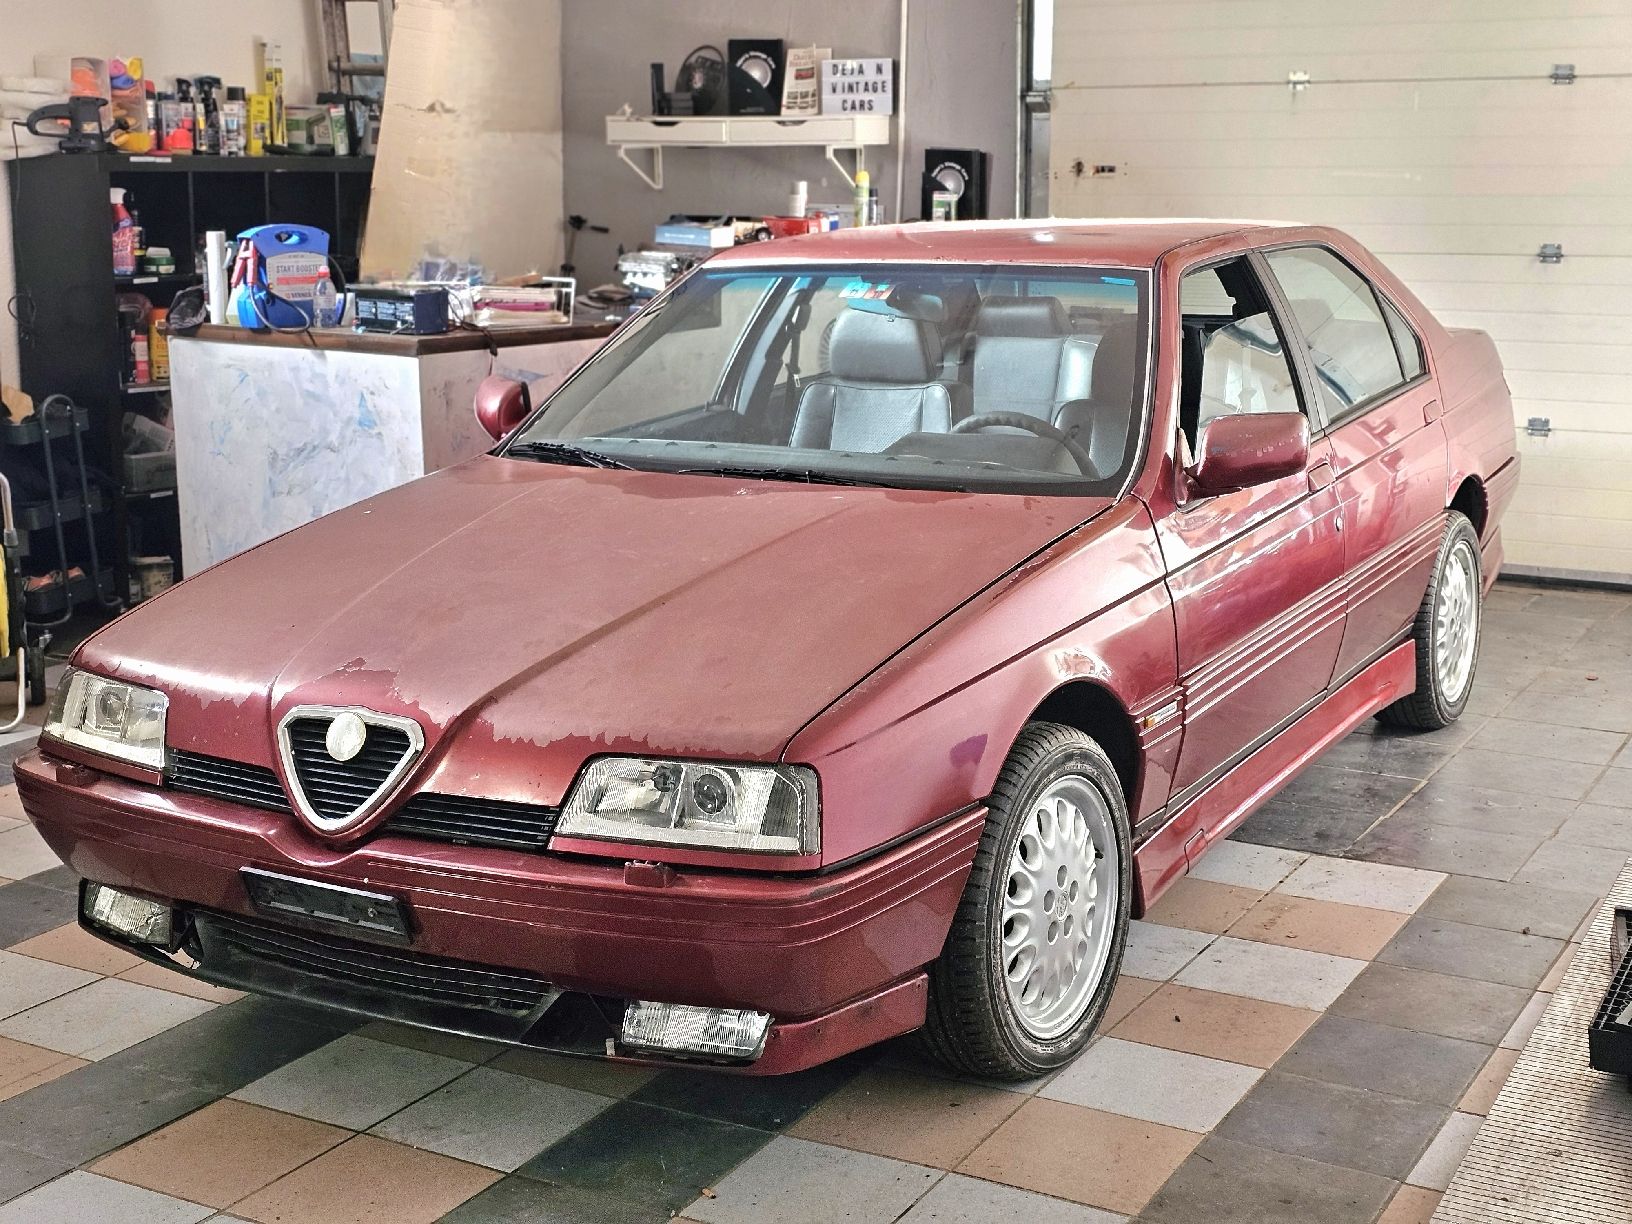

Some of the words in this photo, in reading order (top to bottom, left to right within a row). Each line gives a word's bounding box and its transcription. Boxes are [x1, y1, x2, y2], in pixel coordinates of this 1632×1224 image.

[876, 63, 883, 75] N
[831, 80, 887, 94] VINTAGE
[842, 98, 874, 111] CARS
[276, 264, 295, 274] START
